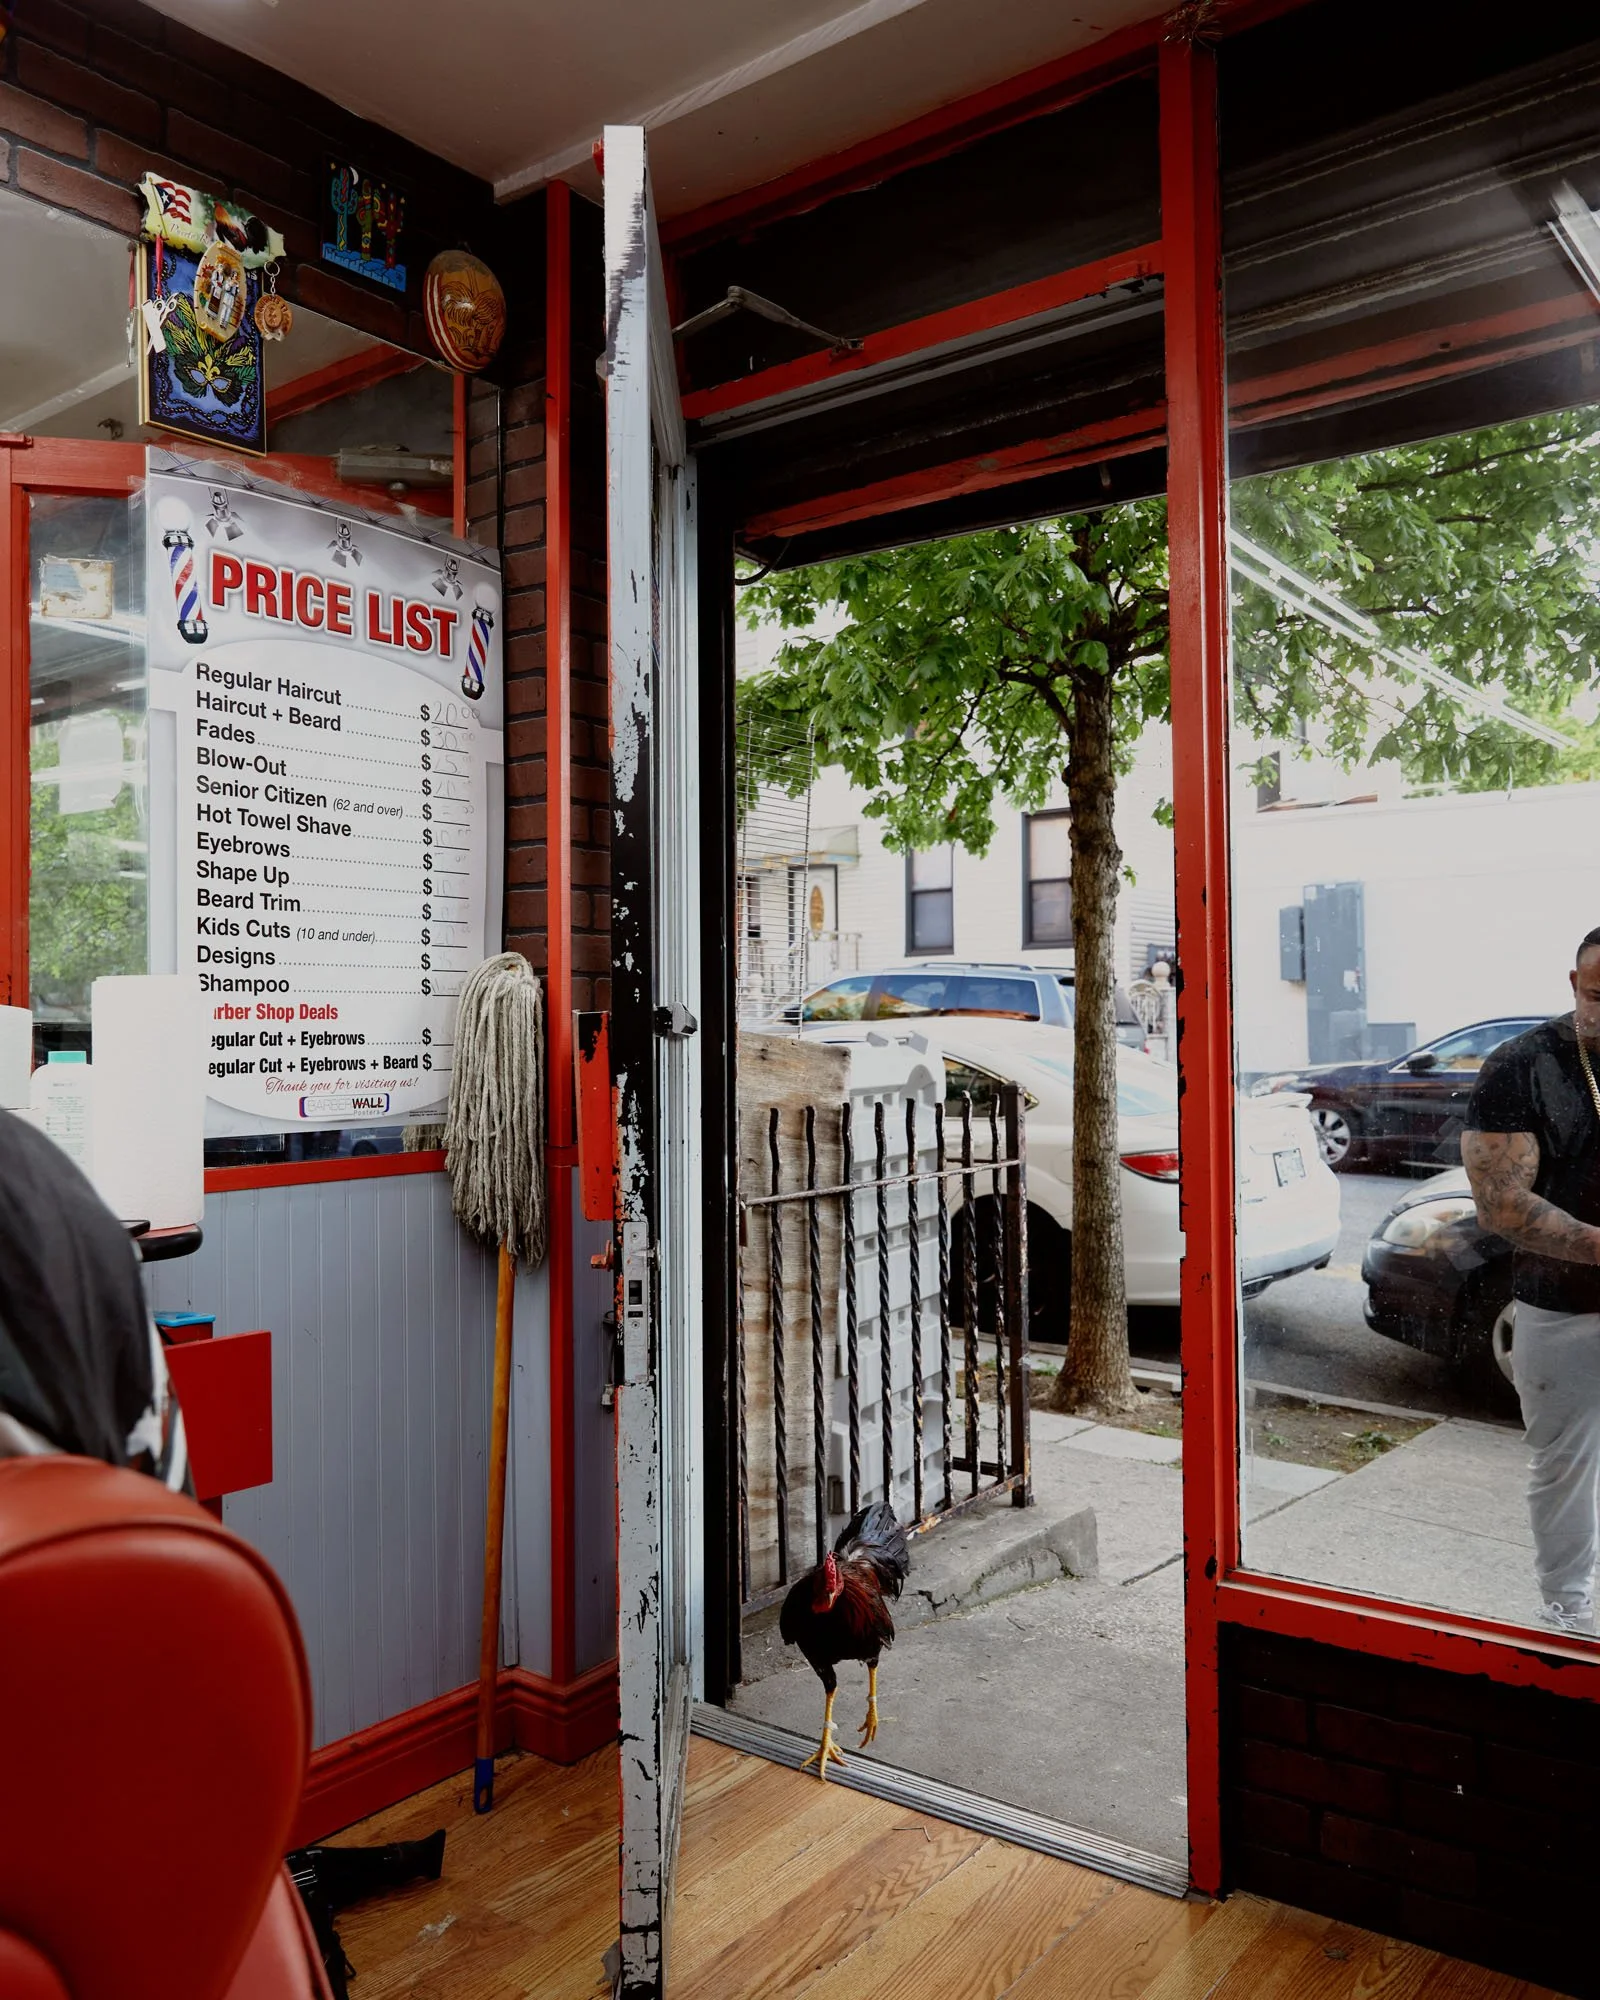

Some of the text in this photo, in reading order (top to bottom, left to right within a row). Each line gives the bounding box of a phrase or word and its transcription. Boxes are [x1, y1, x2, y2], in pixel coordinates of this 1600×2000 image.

[212, 553, 457, 656] PRICE LIST
[196, 662, 430, 722] Regular Haircut $
[196, 690, 431, 747] Haircut + Beard $
[196, 718, 431, 771] Fades $
[196, 746, 287, 776] Blow-Out
[422, 778, 431, 796] $
[196, 774, 259, 800] Senior
[264, 784, 327, 808] Citizen
[333, 798, 350, 812] (62
[353, 803, 374, 814] and
[377, 805, 403, 819] over)
[422, 803, 432, 821] $
[197, 803, 433, 846] Hot Towel Shave $
[197, 831, 290, 858] Eyebrows
[423, 852, 433, 871] $
[196, 860, 433, 896] Shape Up $
[197, 888, 254, 909] Beard
[259, 892, 301, 912] Trim
[422, 903, 431, 921] $
[197, 916, 431, 946] Kids Cuts (10 and under) $
[197, 945, 276, 968] Designs
[421, 952, 431, 971] $
[199, 973, 290, 996] Shampoo
[421, 977, 431, 996] $
[213, 1003, 339, 1023] rber Shop Deals
[211, 1027, 432, 1051] egular Cut + Eyebrows $
[208, 1053, 432, 1078] egular Cut + Eyebrows + Beard $
[265, 1076, 419, 1095] Thank you for visiting us!
